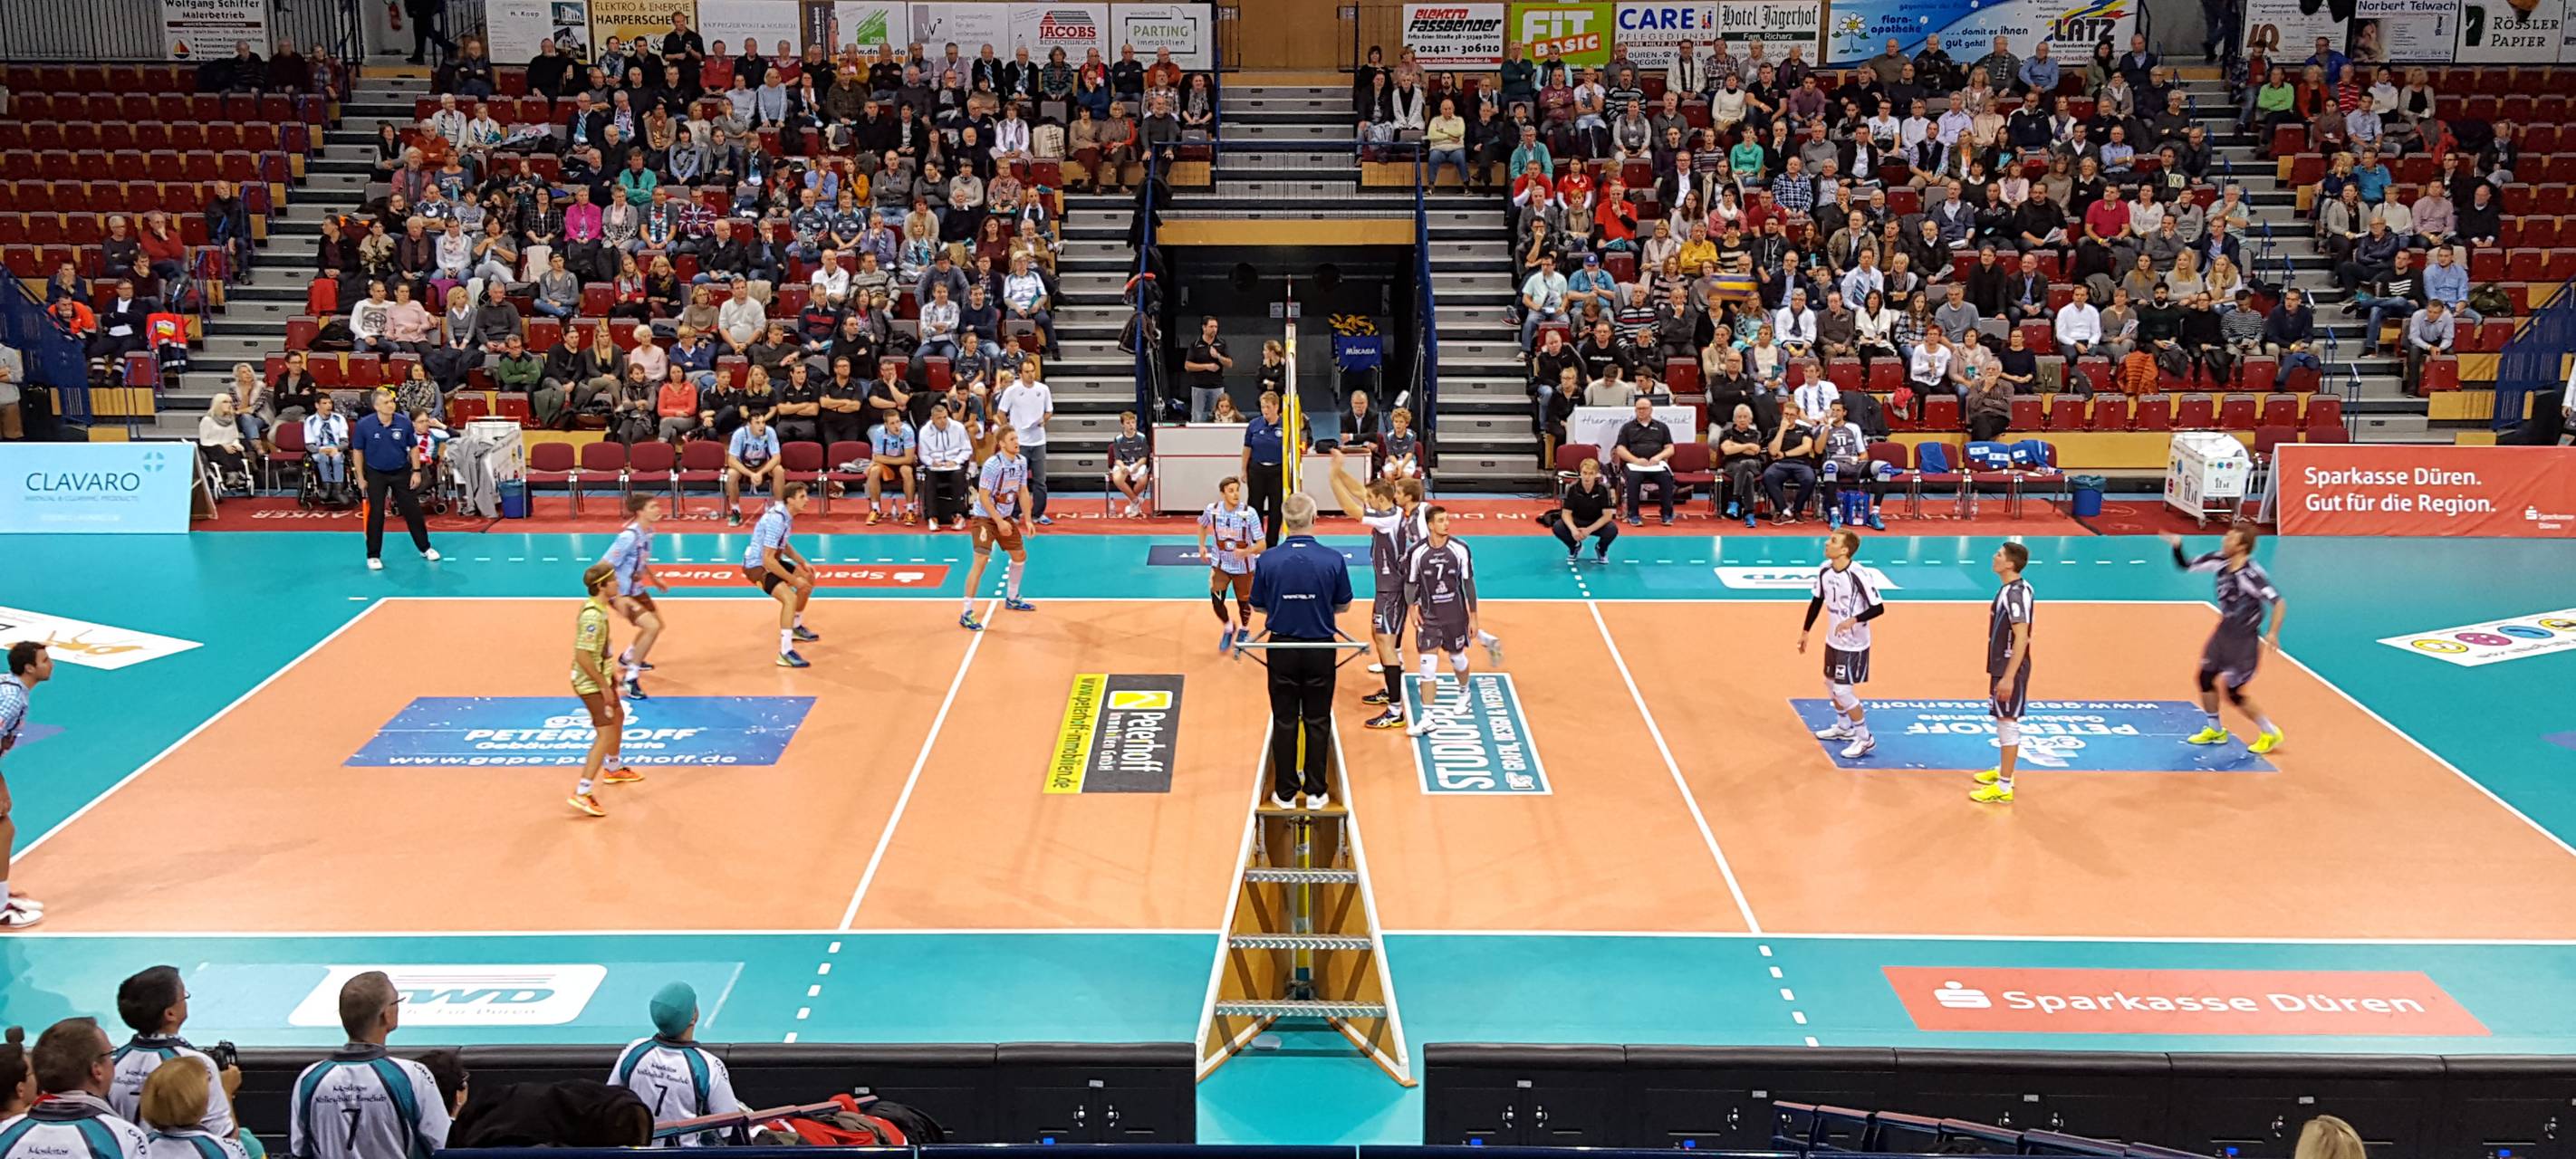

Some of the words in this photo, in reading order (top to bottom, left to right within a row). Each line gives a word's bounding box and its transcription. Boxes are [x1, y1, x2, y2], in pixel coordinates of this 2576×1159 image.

[166, 0, 215, 8] Wolfgang
[218, 0, 260, 8] Schiffer
[594, 2, 636, 12] ELEKTRO
[639, 2, 647, 12] &
[649, 2, 691, 12] ENERGIE
[2358, 1, 2405, 11] Norbert
[2409, 1, 2456, 11] Telwach
[182, 11, 245, 19] Malerbetrieb
[595, 14, 691, 25] HARPERSCHET
[1618, 8, 1696, 31] CARE
[1721, 5, 1758, 31] Hotel
[1760, 5, 1818, 30] Jägerhof
[1880, 14, 1913, 24] flora-
[1522, 10, 1594, 44] FIT
[1961, 27, 1986, 35] damit
[2000, 25, 2029, 35] ihnen
[2053, 17, 2116, 42] LATZ
[2493, 15, 2560, 31] RÖSSLER
[1039, 25, 1097, 39] JACOBS
[1132, 24, 1189, 37] PARTING
[1618, 33, 1715, 41] PFLEGEDIENST
[1764, 33, 1793, 41] Richarz
[1534, 34, 1599, 57] BASIC
[1945, 39, 1963, 49] gut
[2490, 34, 2546, 47] PAPIER
[1419, 43, 1451, 55] 02421
[1461, 43, 1500, 54] 306120
[25, 472, 141, 492] CLAVARO
[2304, 466, 2409, 488] Sparkasse
[2414, 467, 2483, 486] Düren.
[2305, 493, 2341, 512] Gut
[2346, 493, 2375, 512] für
[2380, 494, 2412, 512] die
[2417, 494, 2497, 517] Region.
[1435, 563, 1444, 580] 7
[464, 728, 697, 742] PETEROFF
[1119, 712, 1167, 772] Peterhoff
[2002, 989, 2258, 1014] Sparkasse
[2266, 992, 2426, 1014] Düren
[654, 1083, 668, 1117] 7
[341, 1107, 361, 1151] 7
